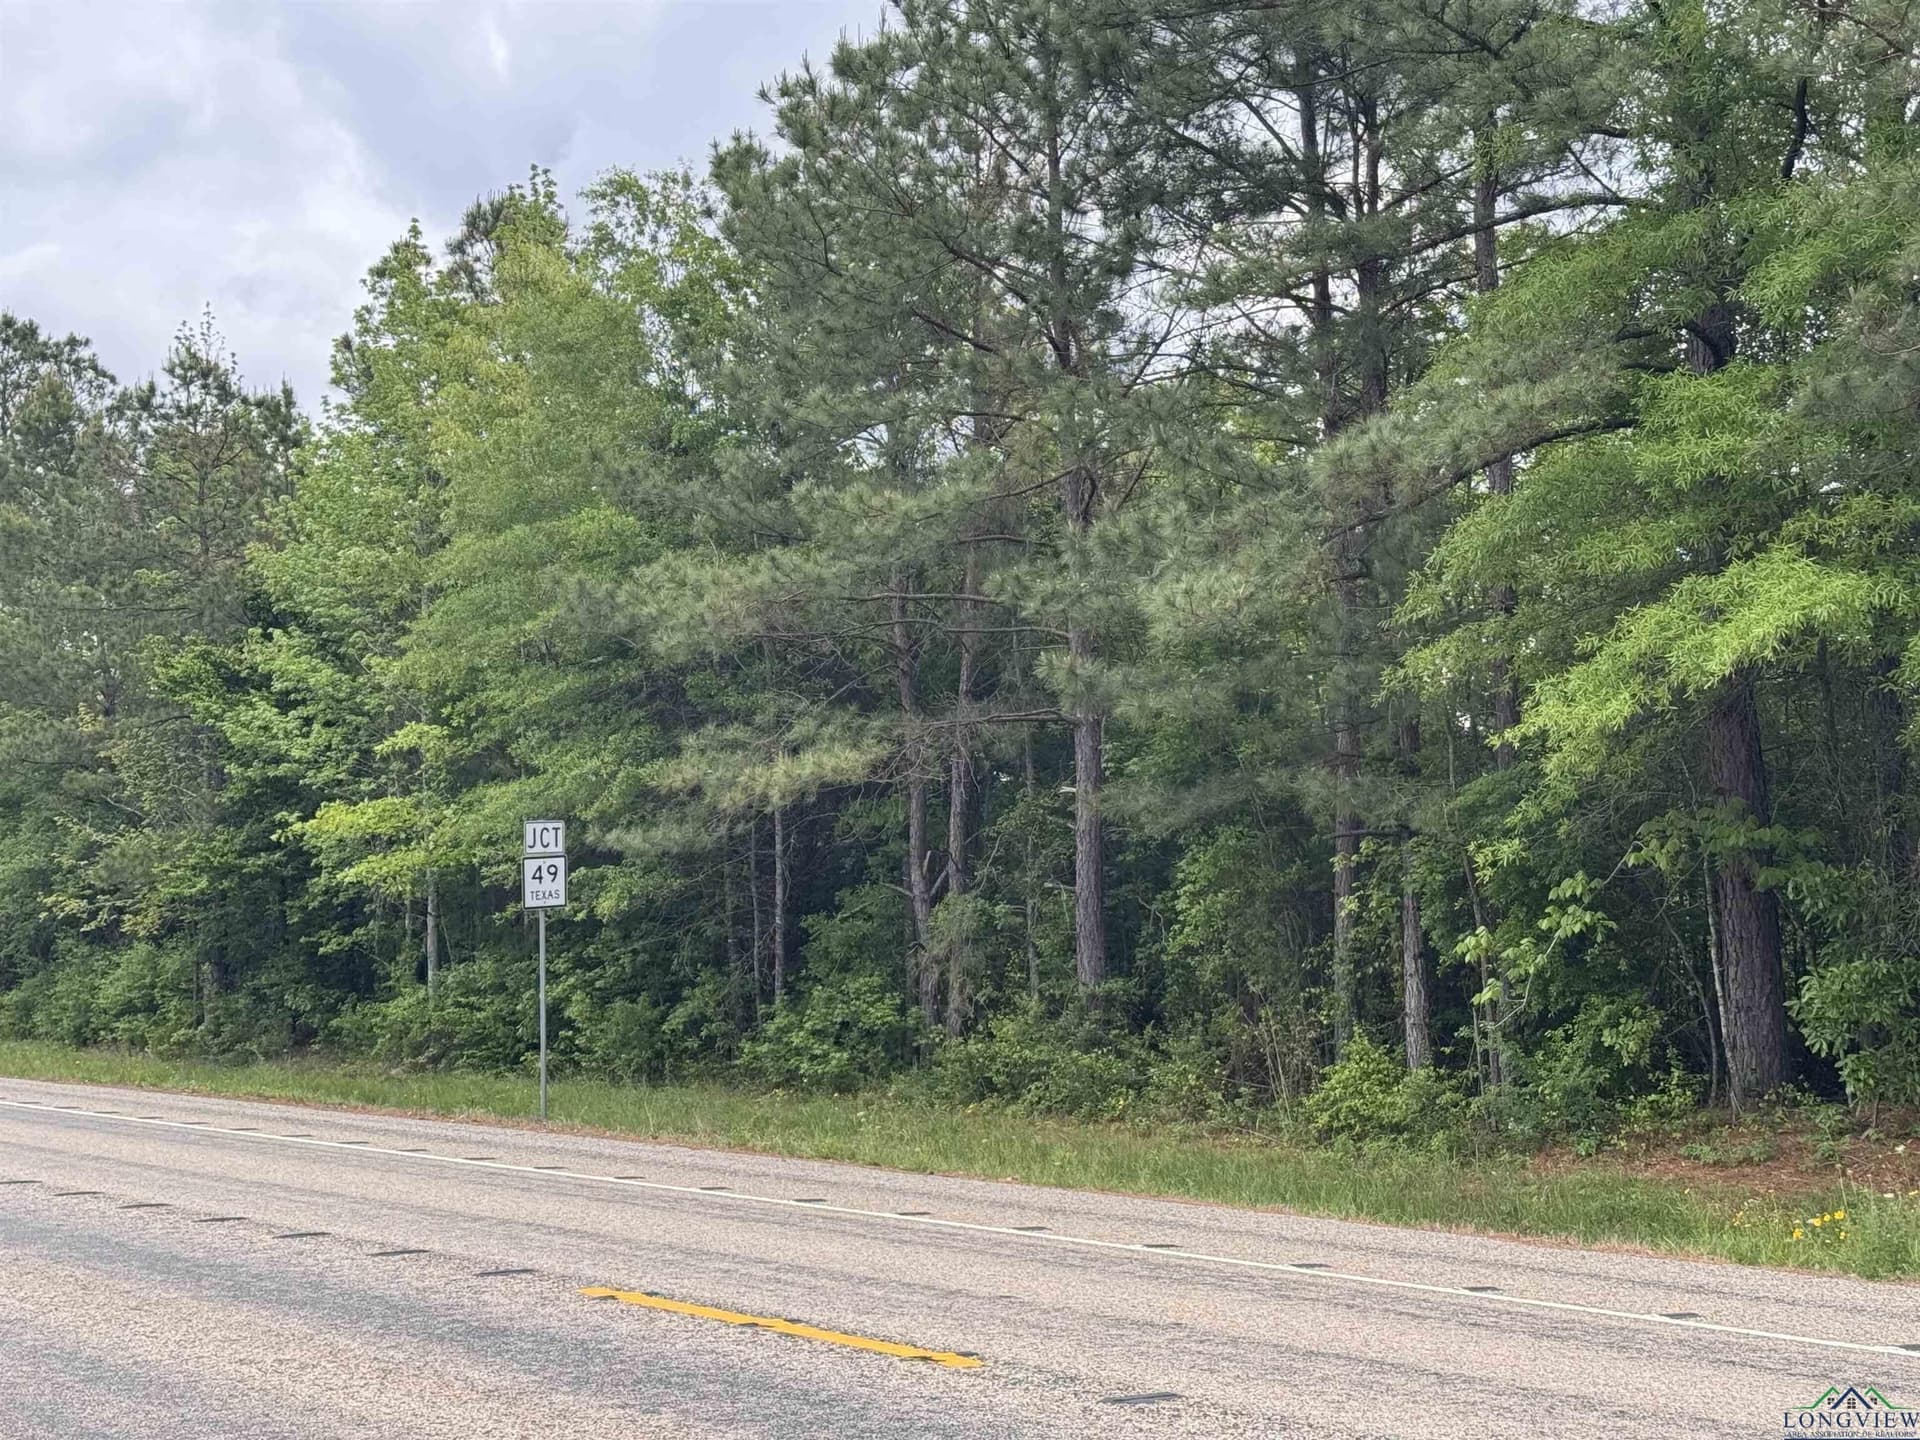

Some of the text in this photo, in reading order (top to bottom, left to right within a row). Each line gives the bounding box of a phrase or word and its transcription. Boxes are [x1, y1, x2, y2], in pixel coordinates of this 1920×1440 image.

[528, 827, 560, 848] JCT
[531, 864, 558, 885] 49
[530, 889, 560, 901] TEXAS
